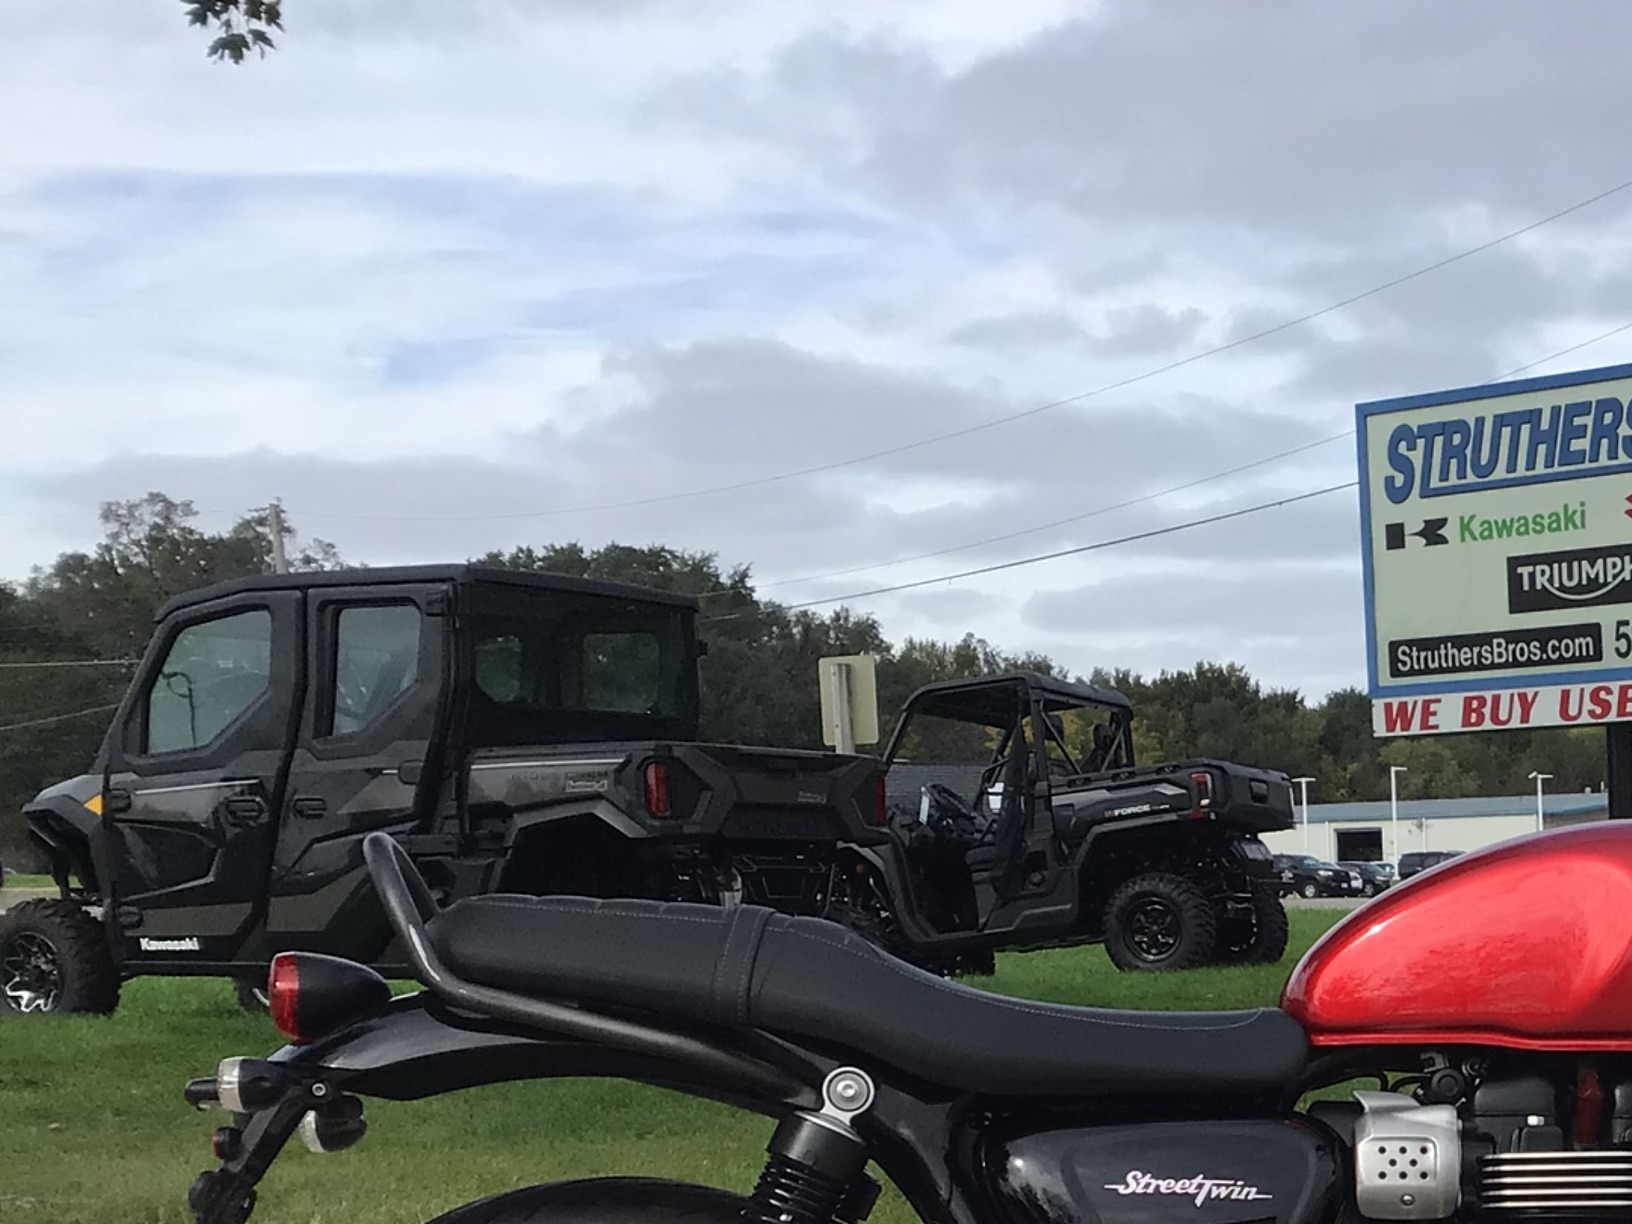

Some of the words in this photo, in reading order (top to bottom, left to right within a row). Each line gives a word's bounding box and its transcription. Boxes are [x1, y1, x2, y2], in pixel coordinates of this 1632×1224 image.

[1458, 500, 1586, 543] Kawasaki
[1397, 635, 1594, 671] StruthersBros.com
[1383, 698, 1442, 733] WE
[1461, 690, 1540, 728] BUY
[140, 937, 199, 951] Kawasaki
